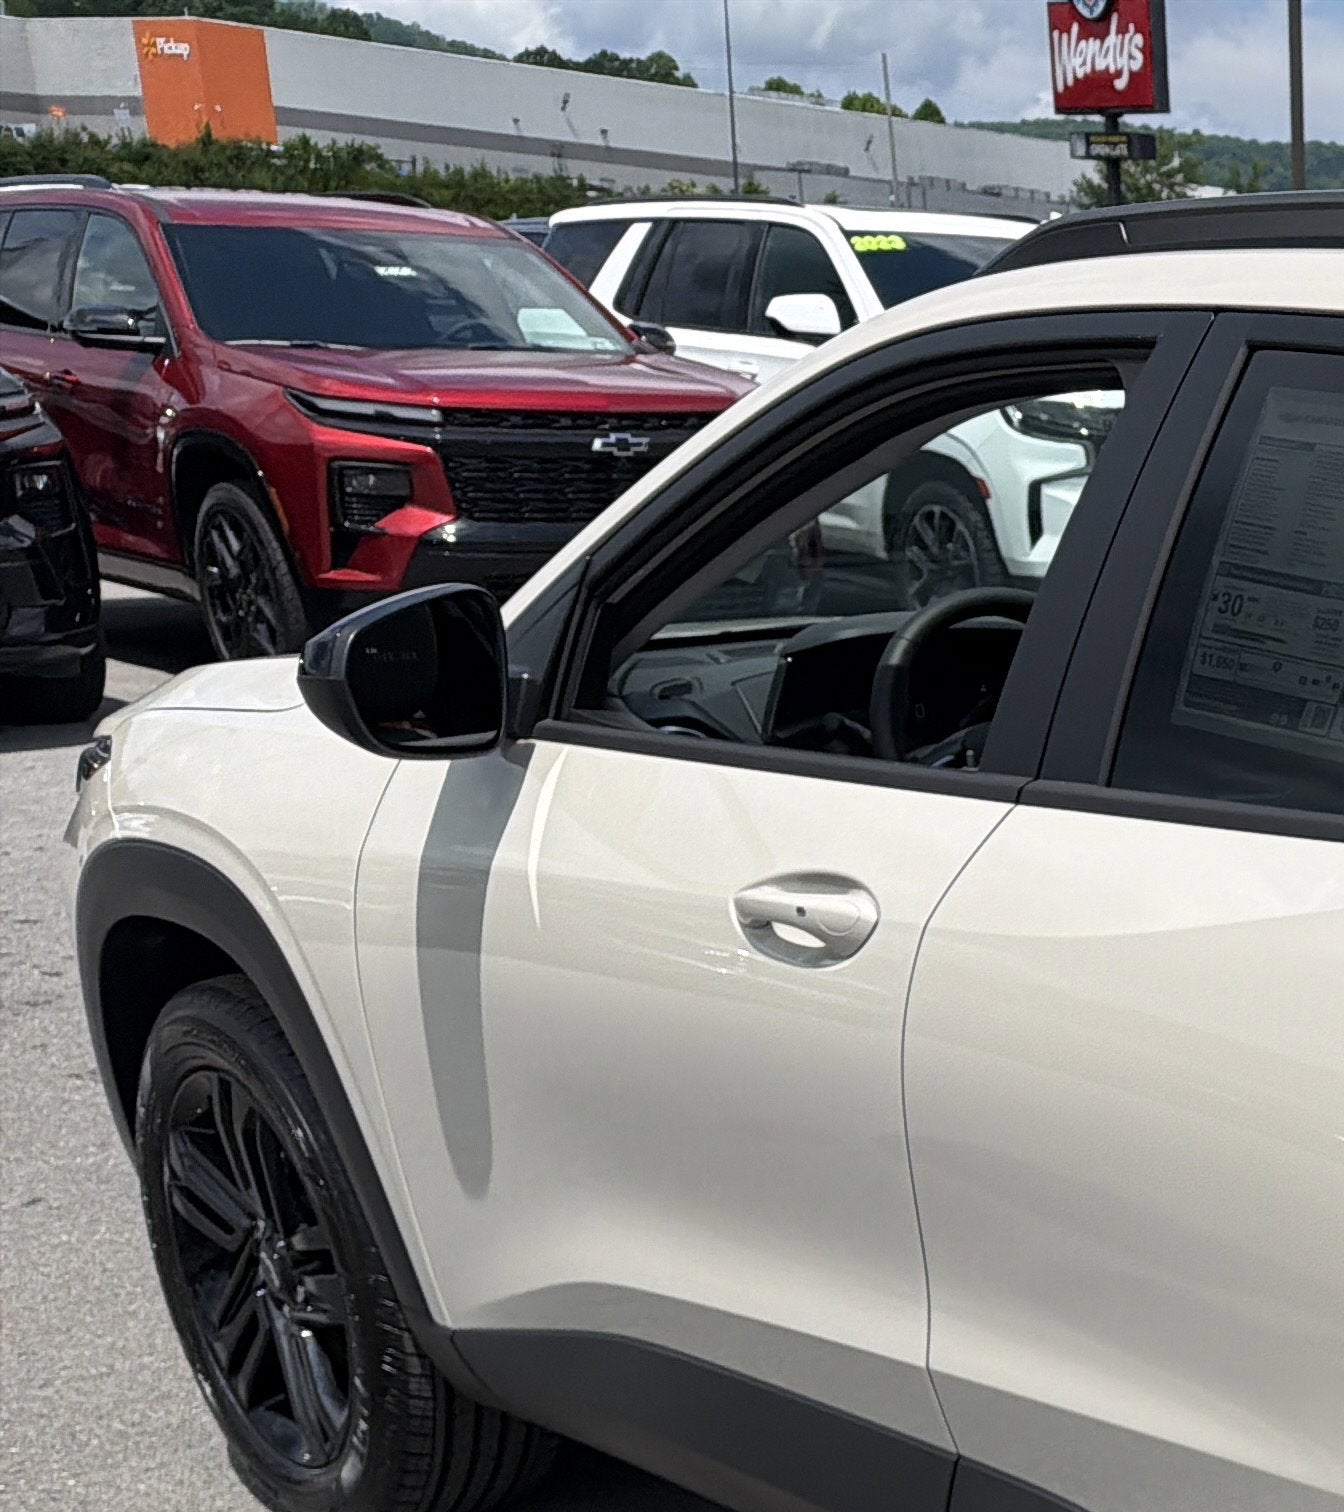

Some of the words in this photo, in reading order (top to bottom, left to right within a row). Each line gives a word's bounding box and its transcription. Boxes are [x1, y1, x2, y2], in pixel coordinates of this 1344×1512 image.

[155, 37, 191, 60] Pickup
[1052, 12, 1144, 93] Wendy's
[1217, 592, 1244, 617] 30
